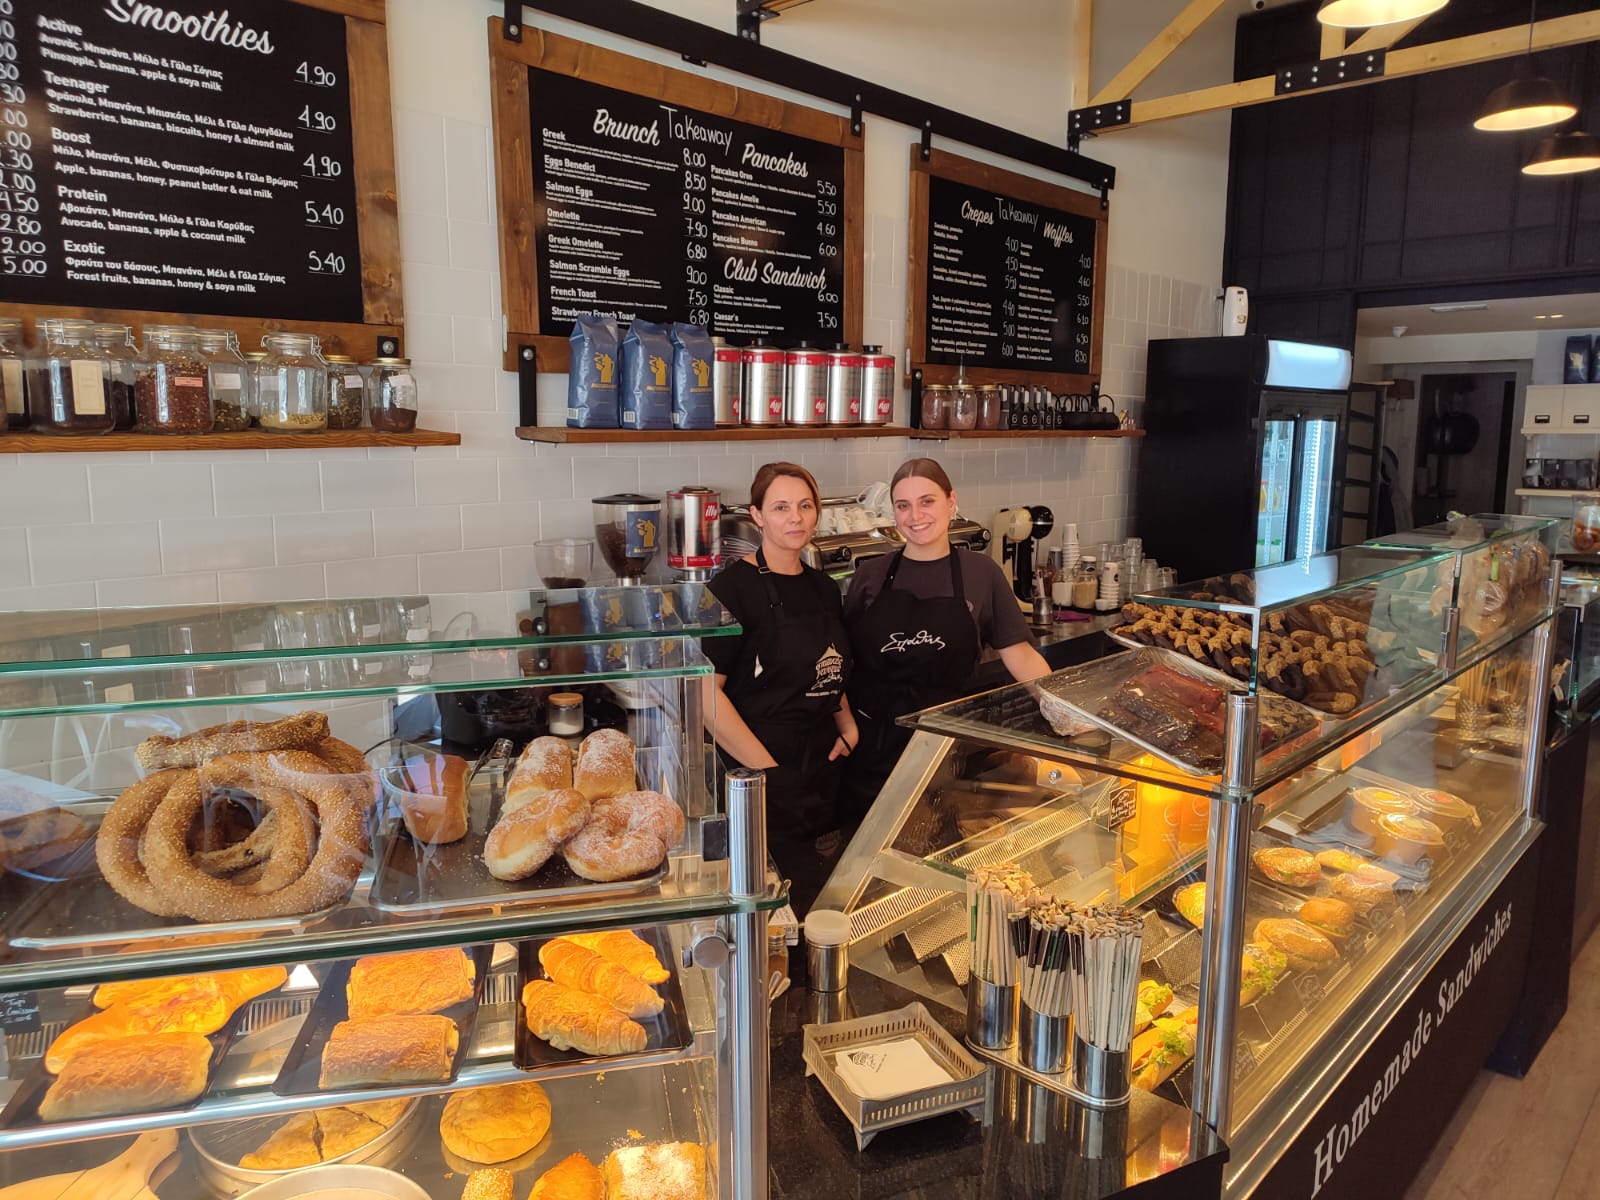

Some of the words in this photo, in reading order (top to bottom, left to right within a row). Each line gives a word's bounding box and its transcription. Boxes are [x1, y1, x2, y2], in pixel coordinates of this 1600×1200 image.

[38, 15, 82, 36] Active
[104, 0, 274, 54] Smoothies
[83, 42, 131, 60] Μπανάνα,
[133, 52, 159, 65] Μήλο
[161, 58, 168, 67] &
[170, 60, 192, 72] Γάλα
[40, 47, 97, 68] Pineapple,
[99, 60, 138, 75] banana,
[141, 67, 166, 80] apple
[169, 74, 176, 82] &
[178, 78, 200, 88] soya
[202, 81, 223, 91] milk
[296, 62, 336, 86] 4.90
[42, 70, 110, 94] Teenager
[98, 98, 145, 114] Μπανάνα,
[195, 114, 216, 126] Μέλι
[218, 119, 225, 128] &
[227, 120, 246, 132] Γάλα
[298, 105, 336, 130] 4.90
[48, 102, 119, 124] Strawberries,
[121, 115, 164, 132] bananas,
[166, 122, 204, 137] biscuits,
[206, 130, 232, 144] honey
[234, 134, 242, 143] &
[243, 136, 275, 149] almond
[276, 142, 295, 151] milk
[51, 127, 91, 144] Boost
[543, 128, 566, 140] Greek
[593, 109, 660, 146] Brunch
[660, 105, 732, 156] Takeaway
[53, 144, 84, 158] Μήλο,
[86, 150, 133, 165] Μπανάνα,
[135, 156, 160, 168] Μέλι,
[237, 171, 244, 180] &
[245, 172, 264, 183] Γάλα
[303, 153, 342, 176] 4.90
[544, 155, 562, 168] Eggs
[565, 158, 596, 172] Benedict
[683, 148, 706, 167] 8.00
[742, 143, 808, 178] Pancakes
[54, 162, 87, 175] Apple,
[90, 166, 134, 181] bananas,
[137, 172, 167, 186] honey,
[169, 178, 200, 190] peanut
[202, 182, 228, 193] butter
[230, 186, 237, 194] &
[239, 188, 252, 196] oat
[254, 190, 273, 199] milk
[711, 165, 738, 178] Pancakes
[57, 185, 108, 202] Protein
[546, 181, 574, 194] Salmon
[576, 186, 593, 197] Eggs
[711, 187, 739, 200] Pancakes
[305, 201, 344, 225] 5.40
[683, 192, 705, 213] 9.00
[961, 200, 994, 226] Crepes
[112, 208, 157, 222] Μπανάνα,
[160, 214, 184, 225] Μήλο
[186, 217, 193, 226] &
[195, 218, 215, 228] Γάλα
[217, 220, 255, 234] Καρύδας
[547, 208, 580, 220] Omelette
[712, 210, 739, 223] Pancakes
[740, 214, 766, 226] American
[995, 197, 1039, 232] Takeaway
[61, 216, 106, 230] Avocado,
[108, 222, 152, 234] bananas,
[154, 228, 179, 238] apple
[181, 230, 189, 238] &
[190, 230, 224, 241] coconut
[226, 235, 246, 244] milk
[712, 232, 739, 244] Pancakes
[1044, 222, 1073, 248] Waffles
[2, 236, 46, 254] 2.00
[64, 239, 106, 254] Exotic
[548, 234, 570, 246] Greek
[572, 238, 604, 249] Omelette
[4, 256, 47, 274] 5.00
[65, 256, 104, 268] Φρούτα
[105, 261, 122, 270] του
[163, 265, 205, 277] Μπανάνα,
[207, 268, 228, 278] Μέλι
[229, 270, 236, 279] &
[238, 270, 257, 281] Γάλα
[308, 251, 345, 273] 5.40
[550, 260, 577, 271] Salmon
[579, 263, 612, 274] Scramble
[613, 267, 629, 278] Eggs
[66, 270, 100, 282] Forest
[101, 273, 131, 284] fruits,
[133, 275, 174, 287] bananas,
[177, 279, 204, 290] honey
[206, 281, 213, 290] &
[215, 283, 235, 293] soya
[237, 284, 256, 293] milk
[724, 257, 757, 282] Club
[761, 262, 826, 290] Sandwich
[551, 286, 576, 297] French
[578, 289, 596, 298] Toast
[713, 284, 734, 294] Classic
[618, 312, 636, 320] Toast
[714, 312, 739, 322] Caesar's
[705, 505, 717, 520] illy
[1310, 1008, 1432, 1200] Homemade
[1436, 902, 1512, 1028] Sandwiches
